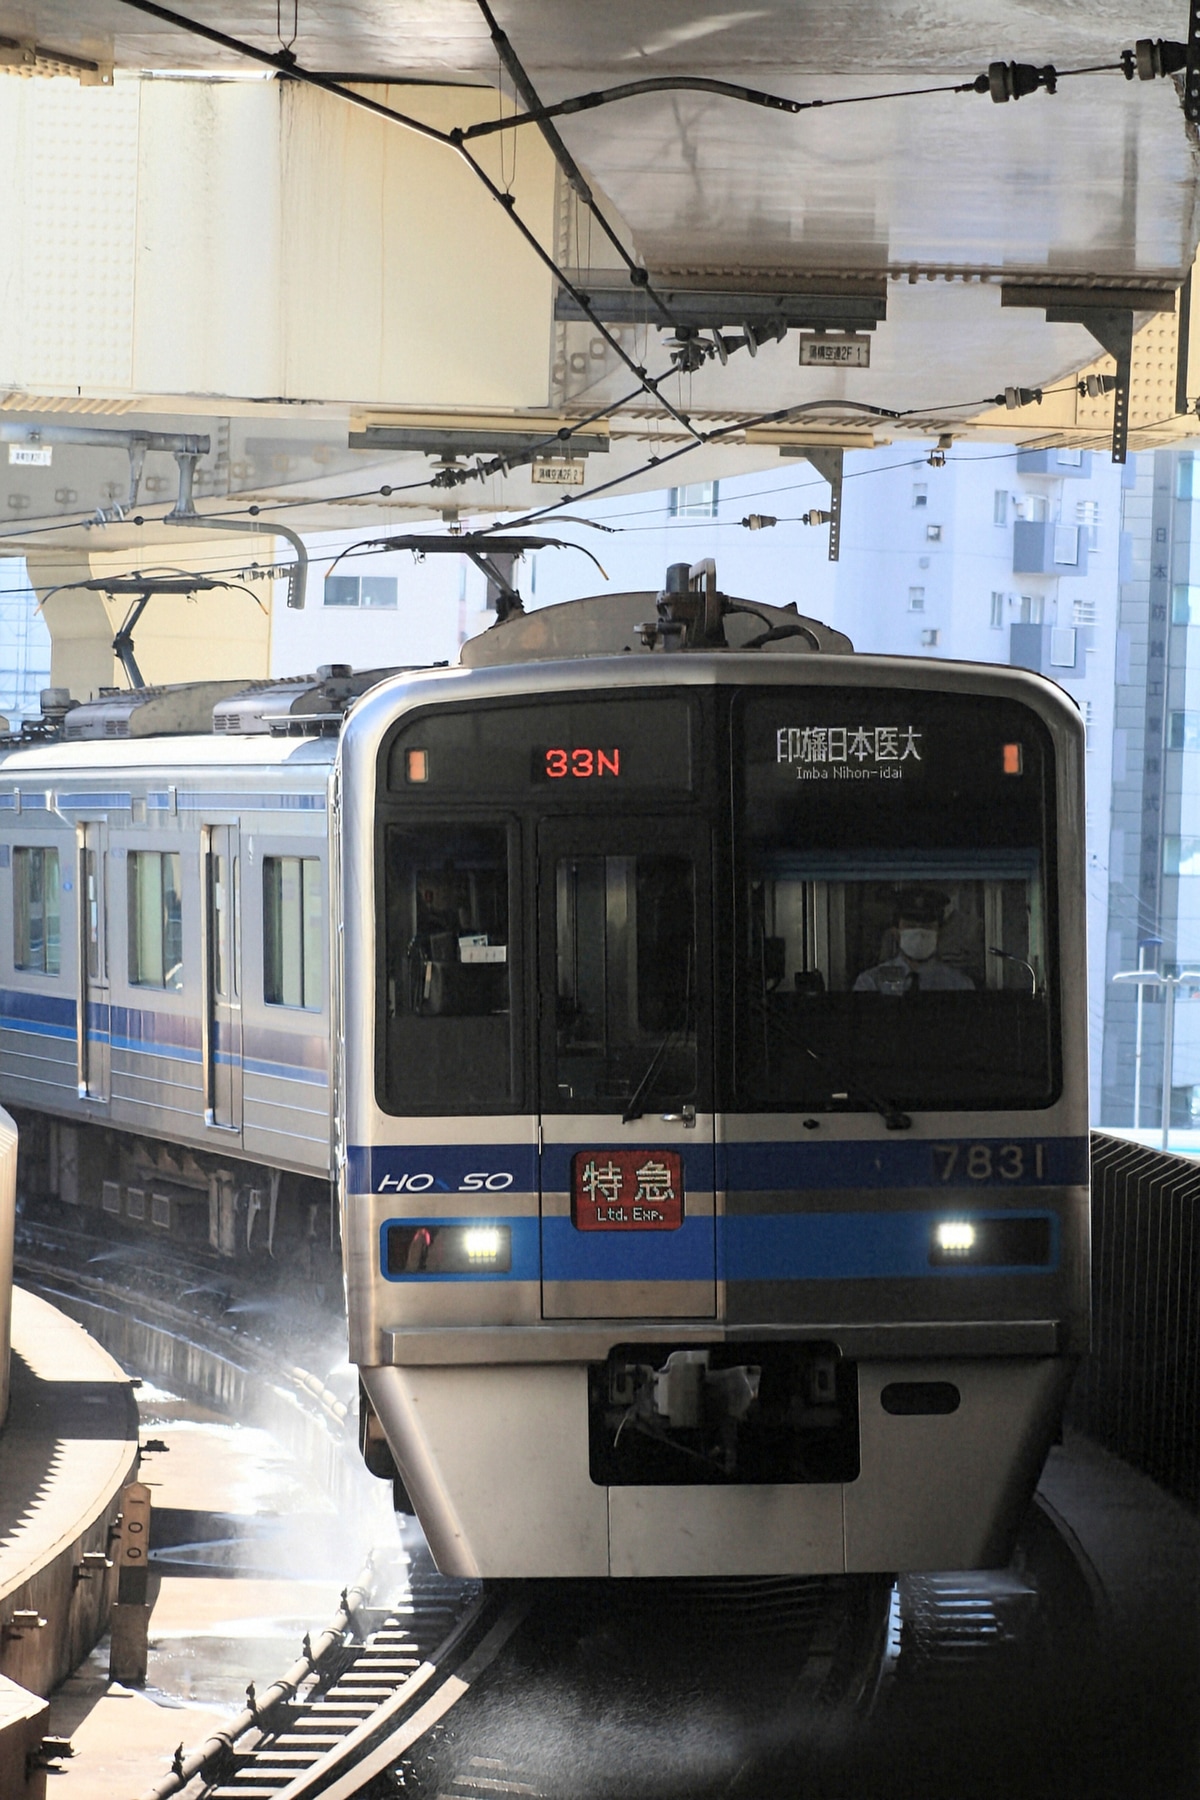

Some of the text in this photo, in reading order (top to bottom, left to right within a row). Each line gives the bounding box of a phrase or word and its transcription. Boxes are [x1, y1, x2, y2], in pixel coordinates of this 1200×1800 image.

[777, 725, 922, 763] 印旛日本医大
[546, 749, 619, 777] 33N
[796, 766, 902, 779] Imba Nihon-idai
[934, 1144, 1043, 1179] 7831
[582, 1160, 675, 1202] 特急
[597, 1207, 664, 1221] Ltd. Exp.
